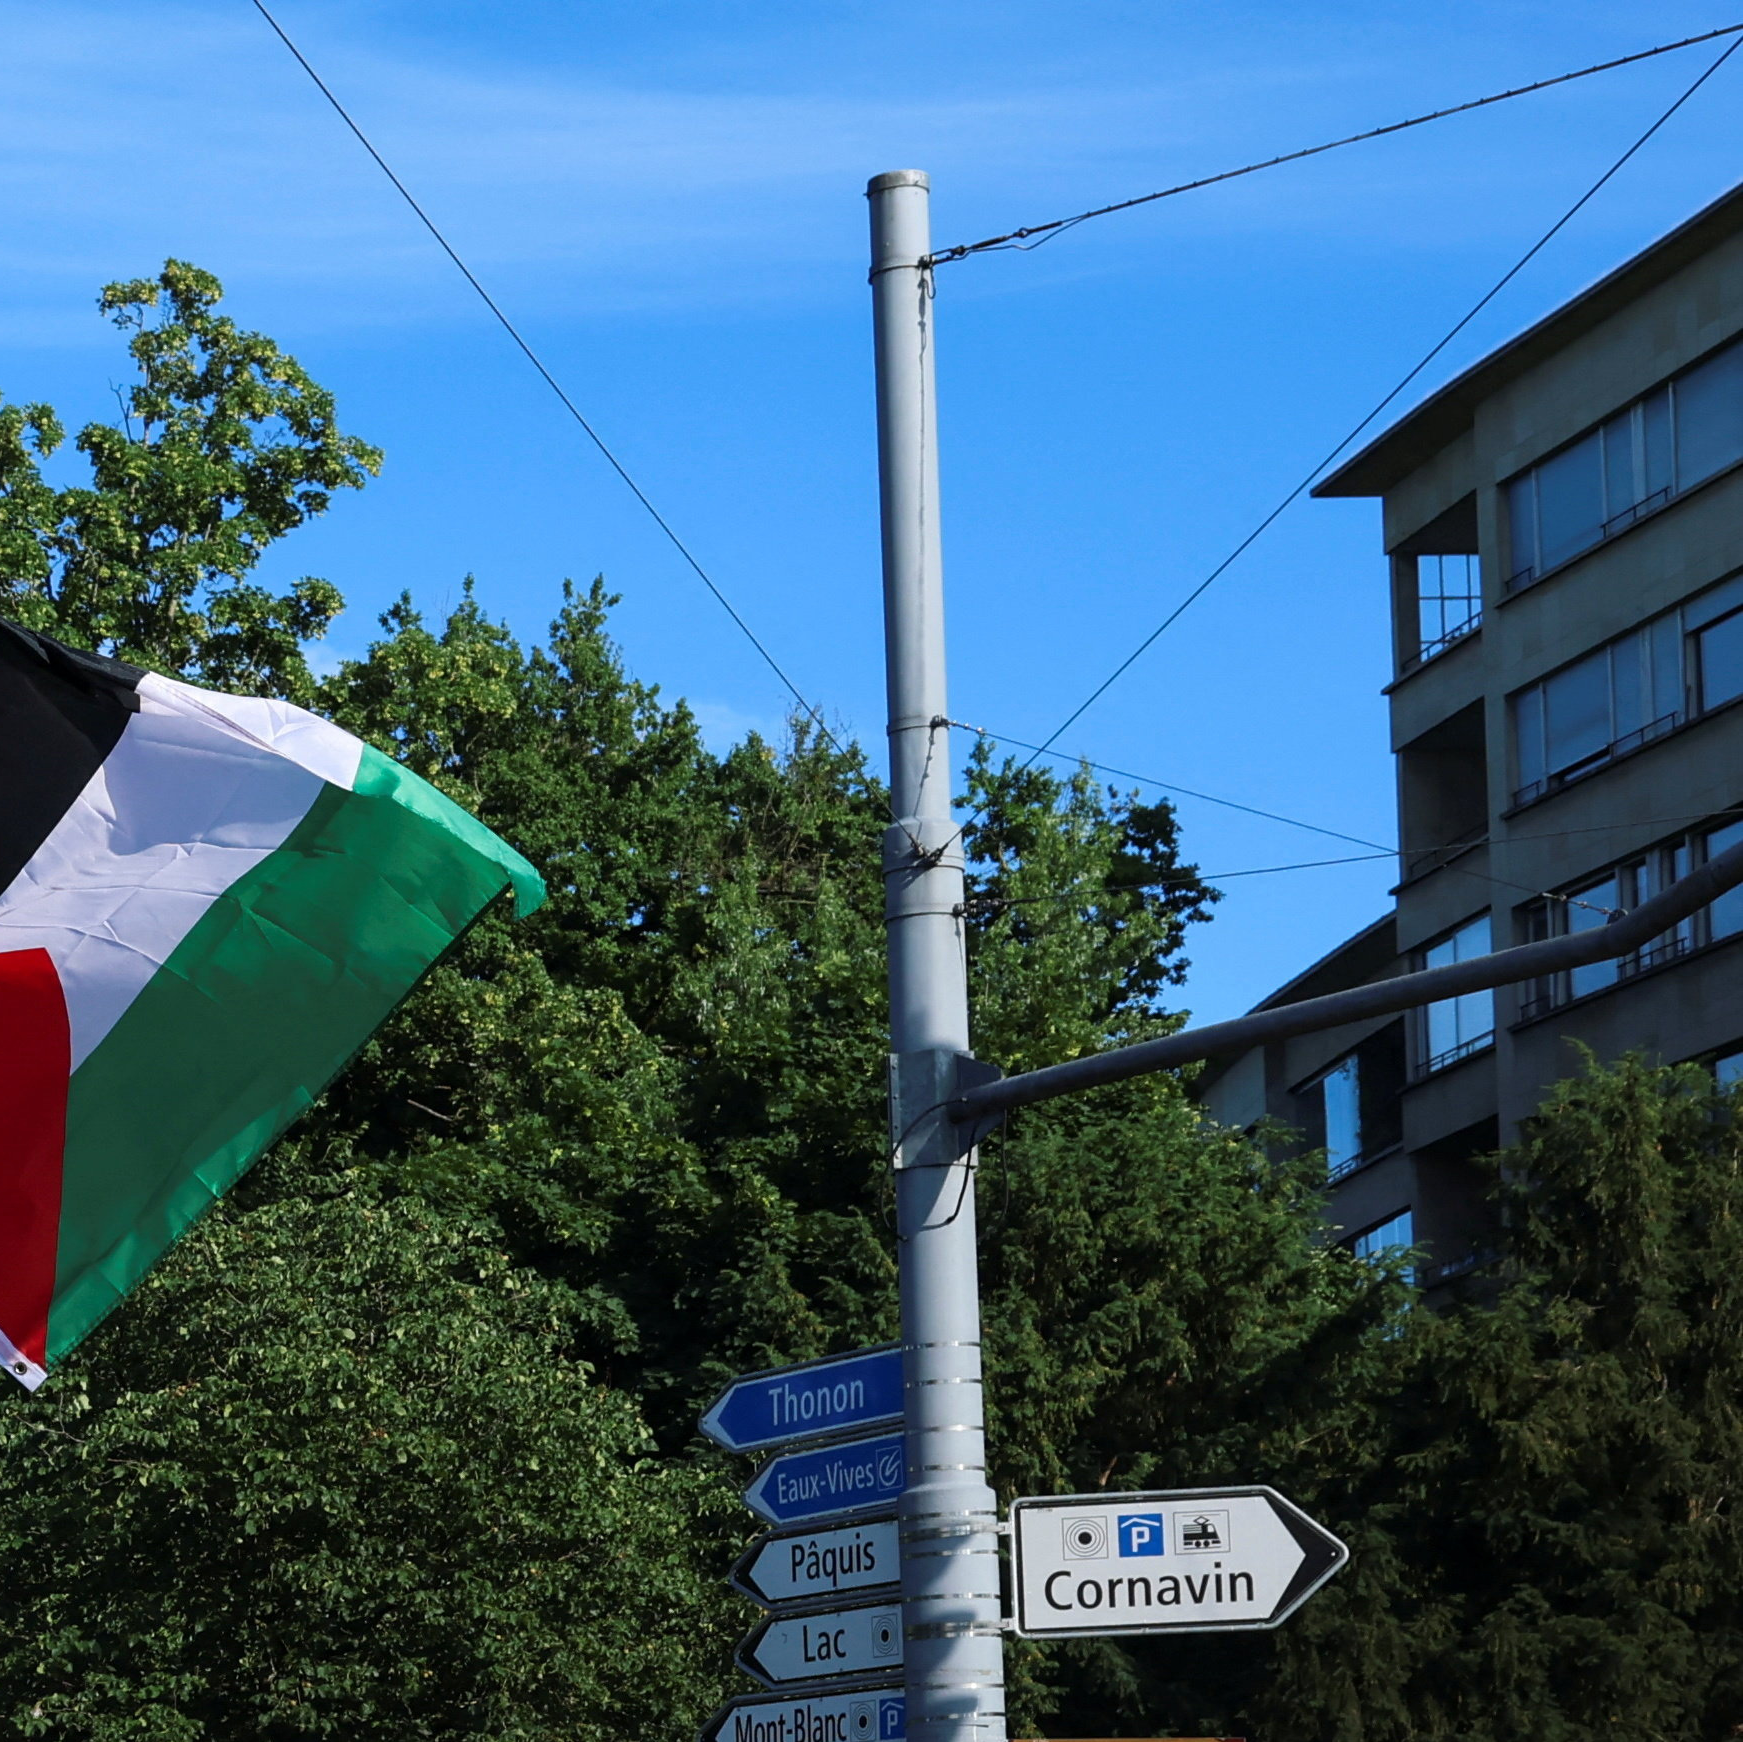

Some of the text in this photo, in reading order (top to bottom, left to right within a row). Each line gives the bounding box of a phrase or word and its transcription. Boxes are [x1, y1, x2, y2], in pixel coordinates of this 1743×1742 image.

[769, 1379, 864, 1426] Thonon
[777, 1460, 875, 1504] Eaux-Vives
[791, 1532, 875, 1587] Pâquis
[1044, 1562, 1254, 1610] Cornavin
[803, 1625, 846, 1662] Lac
